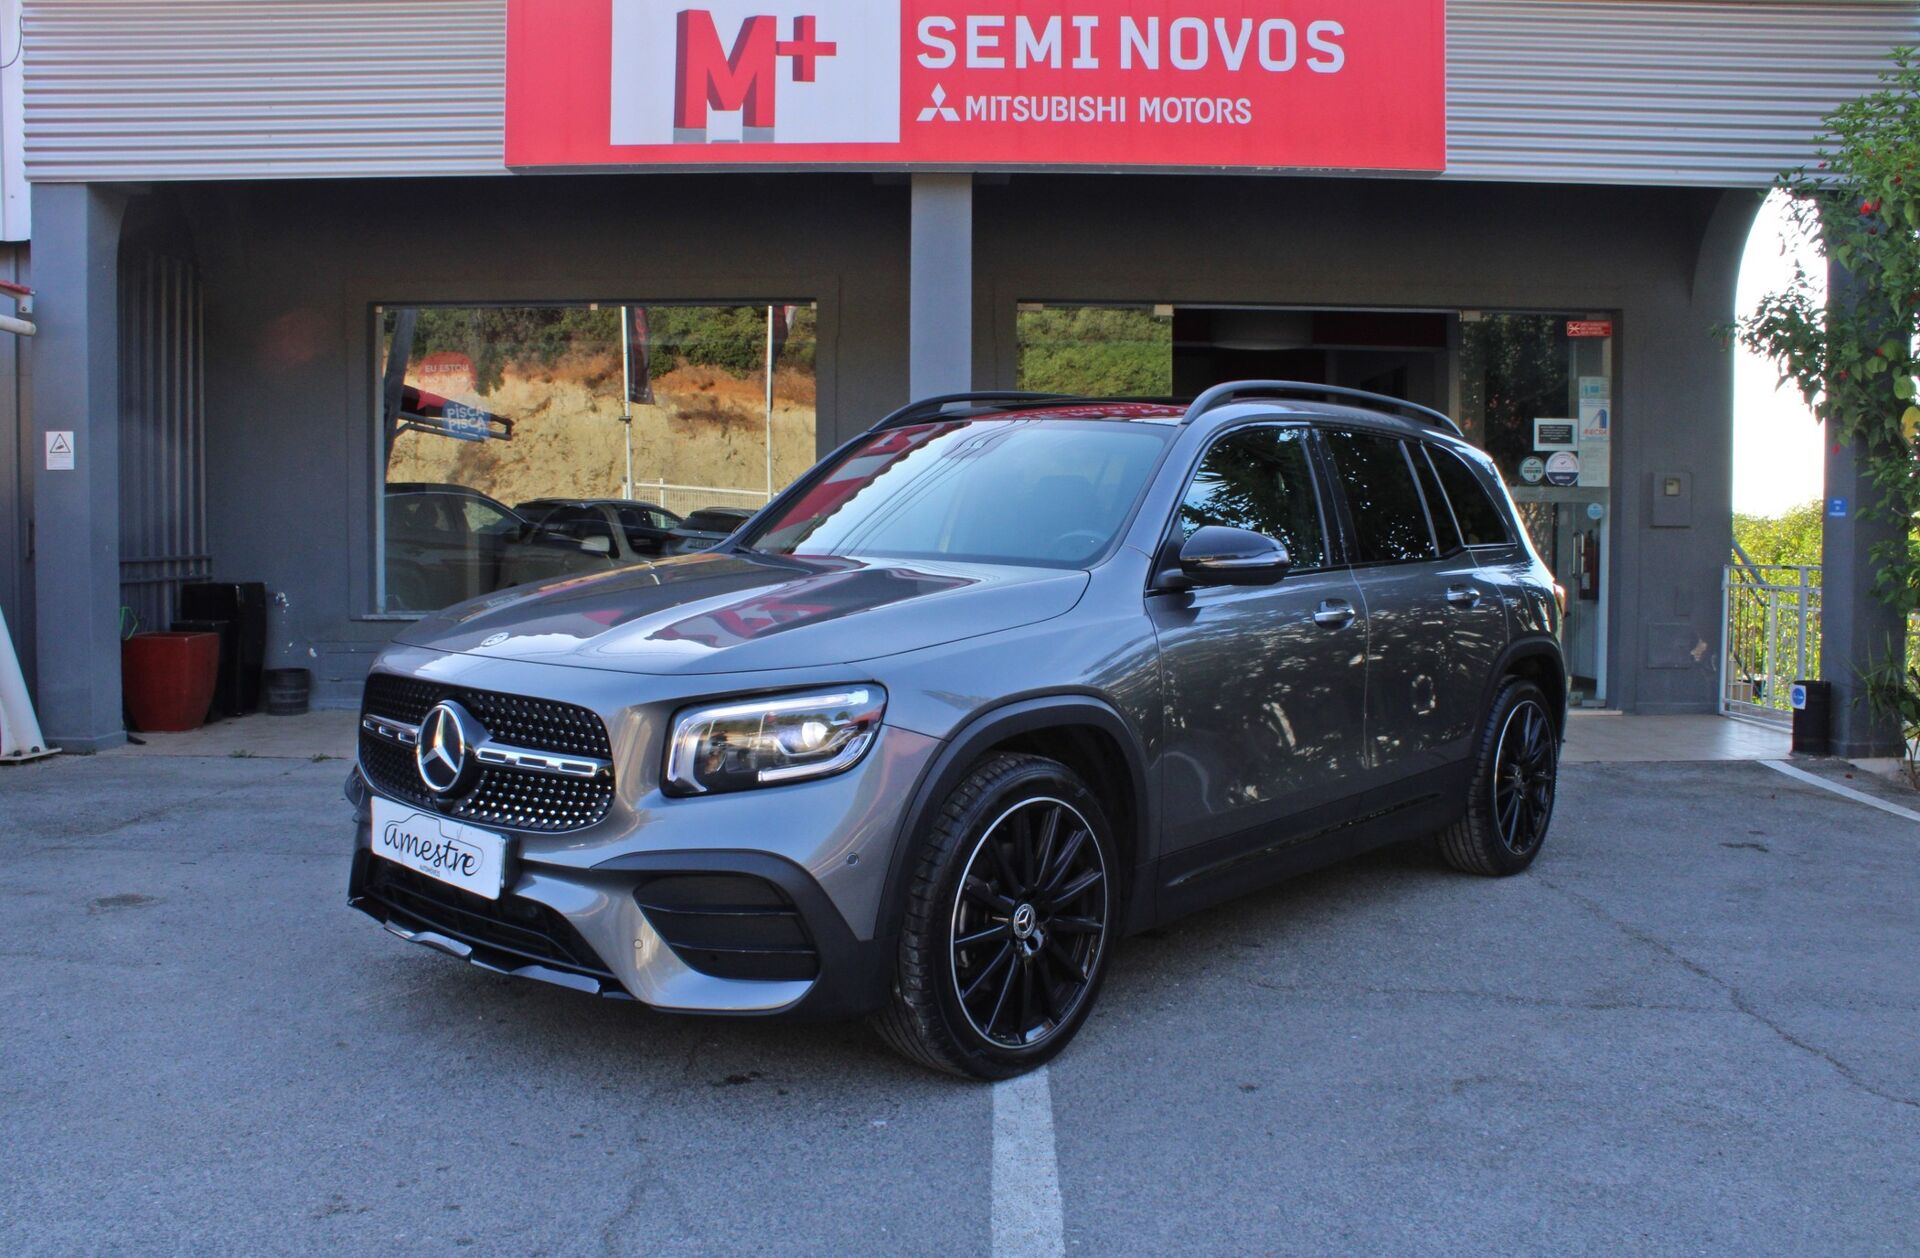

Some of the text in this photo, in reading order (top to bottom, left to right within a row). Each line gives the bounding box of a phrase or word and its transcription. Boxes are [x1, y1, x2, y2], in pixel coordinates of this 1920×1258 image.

[917, 15, 1345, 73] SEMI NOVOS
[965, 95, 1252, 124] MITSUBISHI MOTORS
[424, 363, 469, 373] EU ESTOU
[384, 823, 475, 876] amestre
